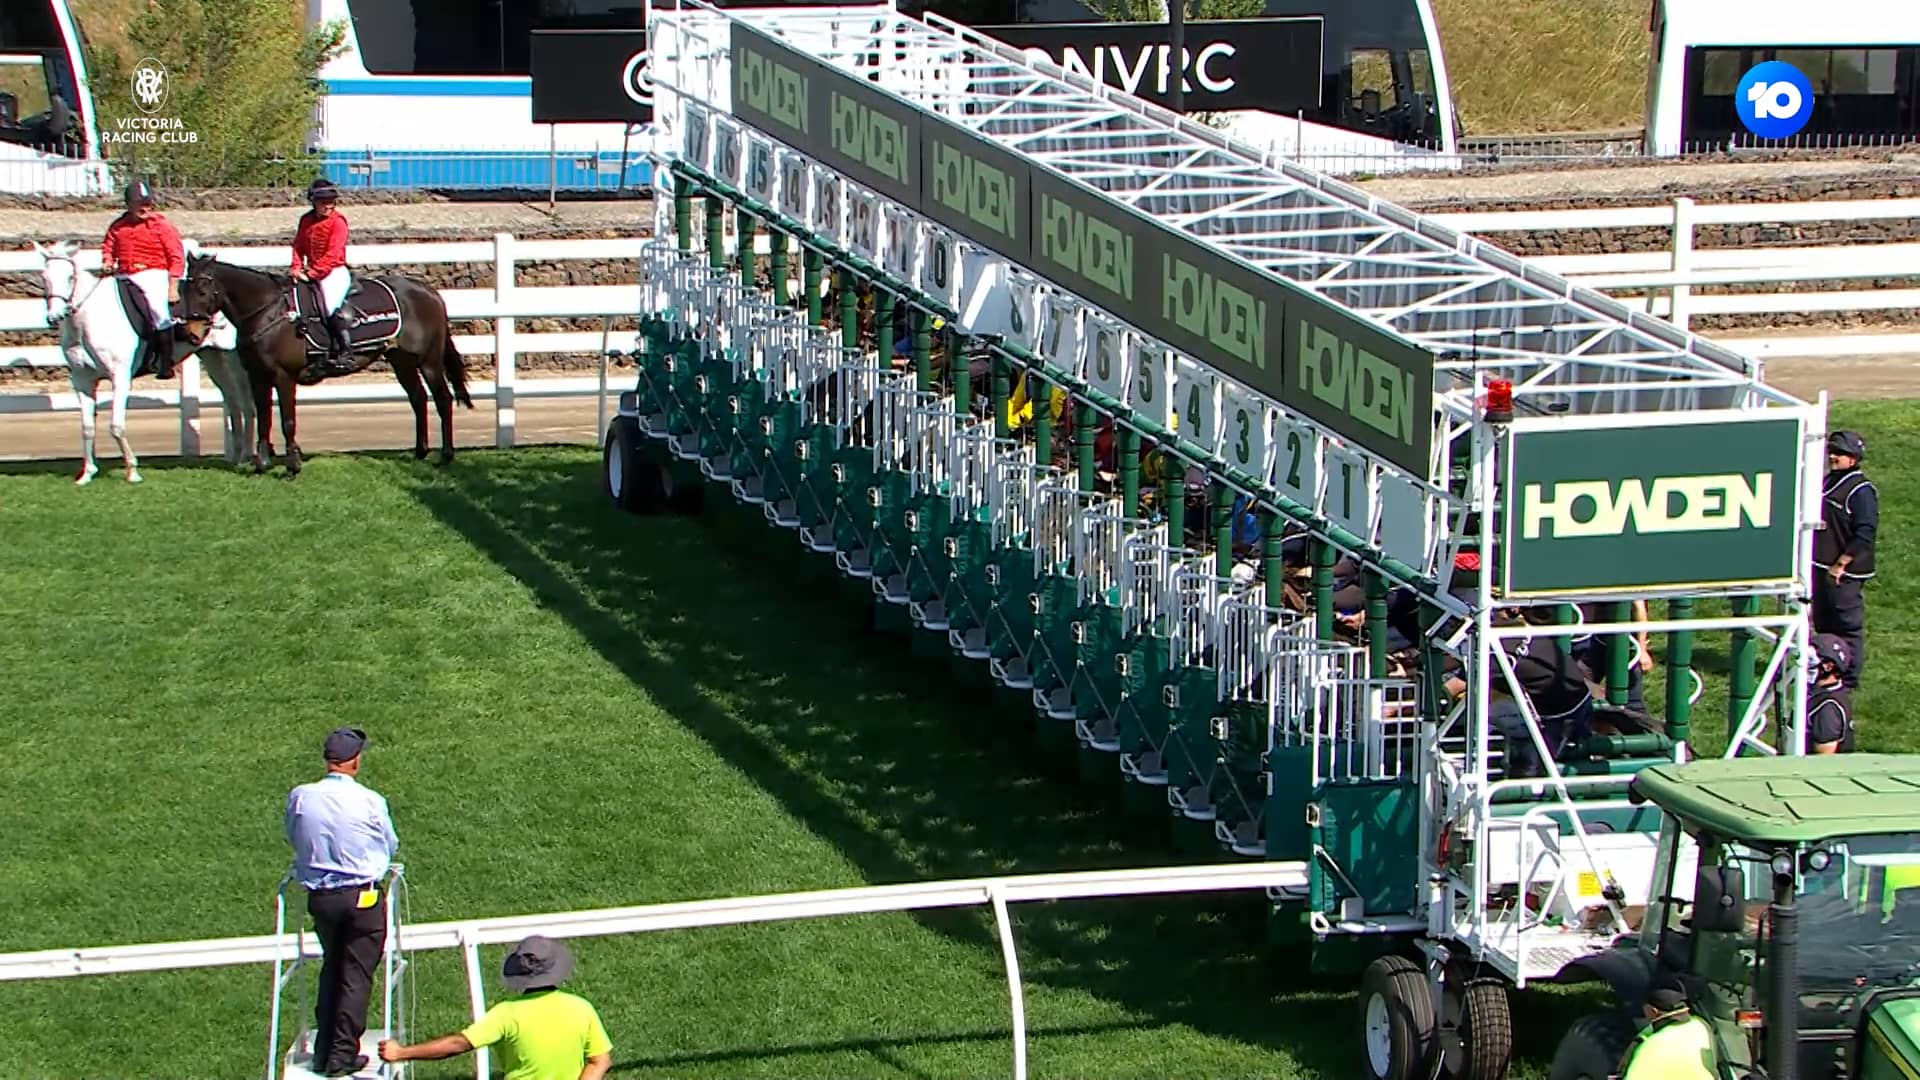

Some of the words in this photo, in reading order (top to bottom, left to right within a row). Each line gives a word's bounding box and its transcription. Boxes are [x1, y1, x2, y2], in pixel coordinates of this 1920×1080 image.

[740, 47, 808, 134] HOWDEN
[718, 123, 735, 178] 16
[831, 90, 908, 185] HOWDEN
[750, 140, 767, 194] 15
[784, 160, 800, 213] 14
[933, 140, 1015, 240] HOWDEN
[818, 178, 834, 229] 13
[1041, 191, 1133, 300] HOWDEN
[1051, 303, 1065, 357] 7
[1163, 253, 1266, 370] HOWDEN
[1096, 329, 1110, 382] 6
[1139, 350, 1152, 402] 5
[1300, 319, 1414, 446] HOWDEN
[1187, 384, 1200, 437] 4
[1236, 408, 1249, 464] 3
[1287, 431, 1300, 490] 2
[1341, 462, 1350, 519] 1
[1523, 472, 1772, 539] HOWDEN
